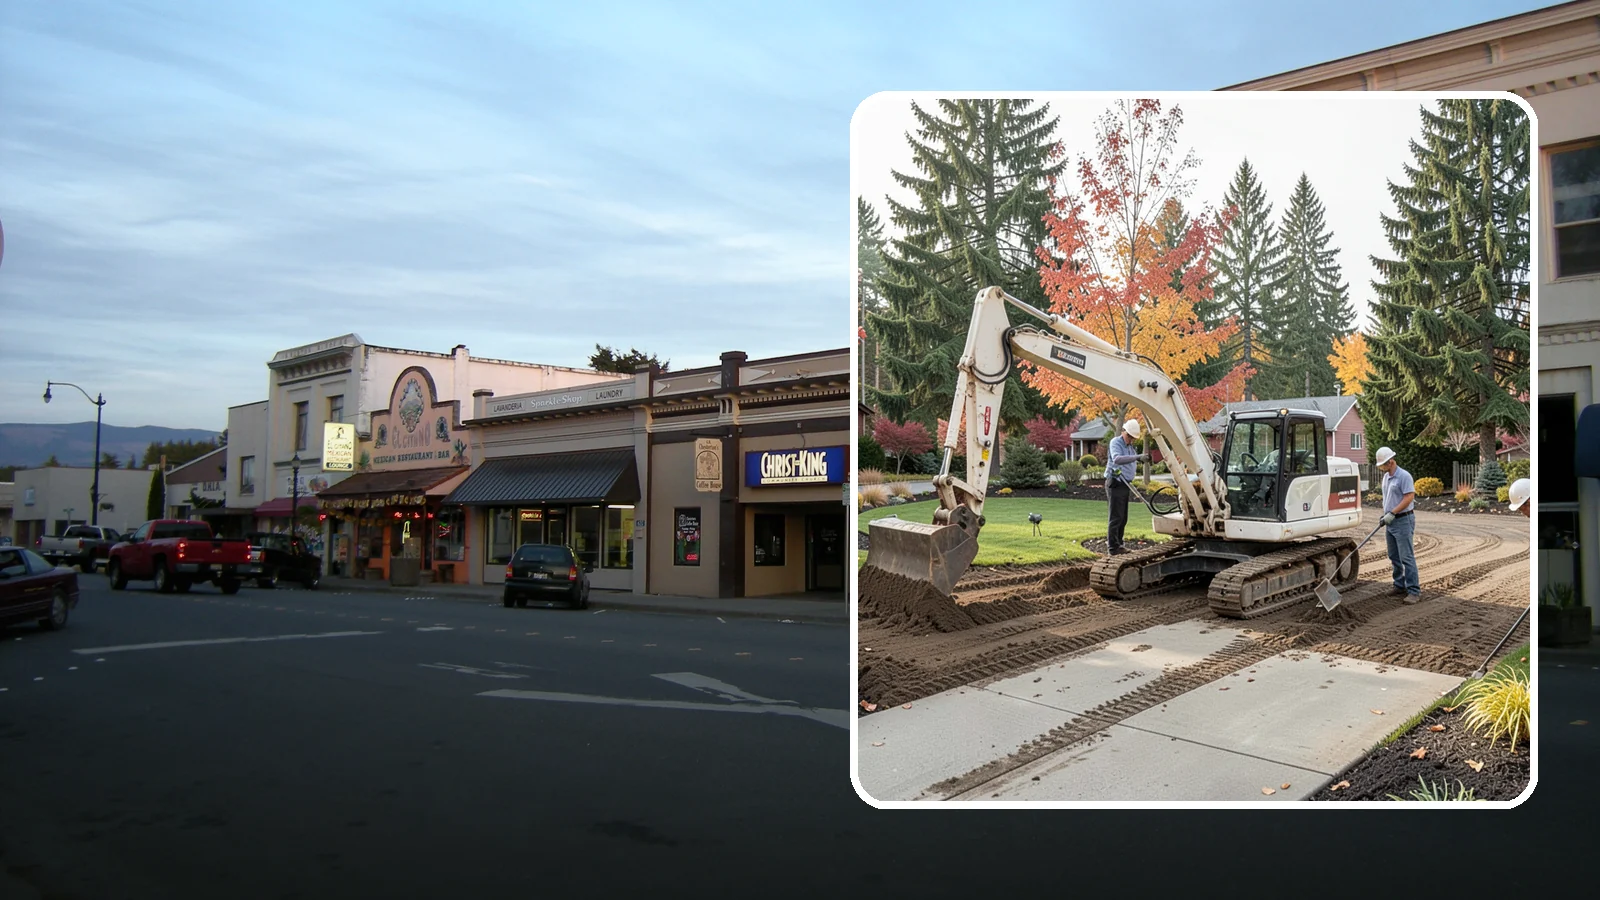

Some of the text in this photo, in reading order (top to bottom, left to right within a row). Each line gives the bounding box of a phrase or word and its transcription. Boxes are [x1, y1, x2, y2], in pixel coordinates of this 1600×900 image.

[530, 394, 582, 409] Sparkle Shop
[595, 389, 624, 400] LAUNDRY
[493, 402, 523, 413] LAVANDERIA
[373, 455, 396, 465] MEXICAN
[397, 452, 434, 462] RESTAURANT
[438, 450, 450, 459] BAR
[761, 450, 827, 478] CHRIST KING
